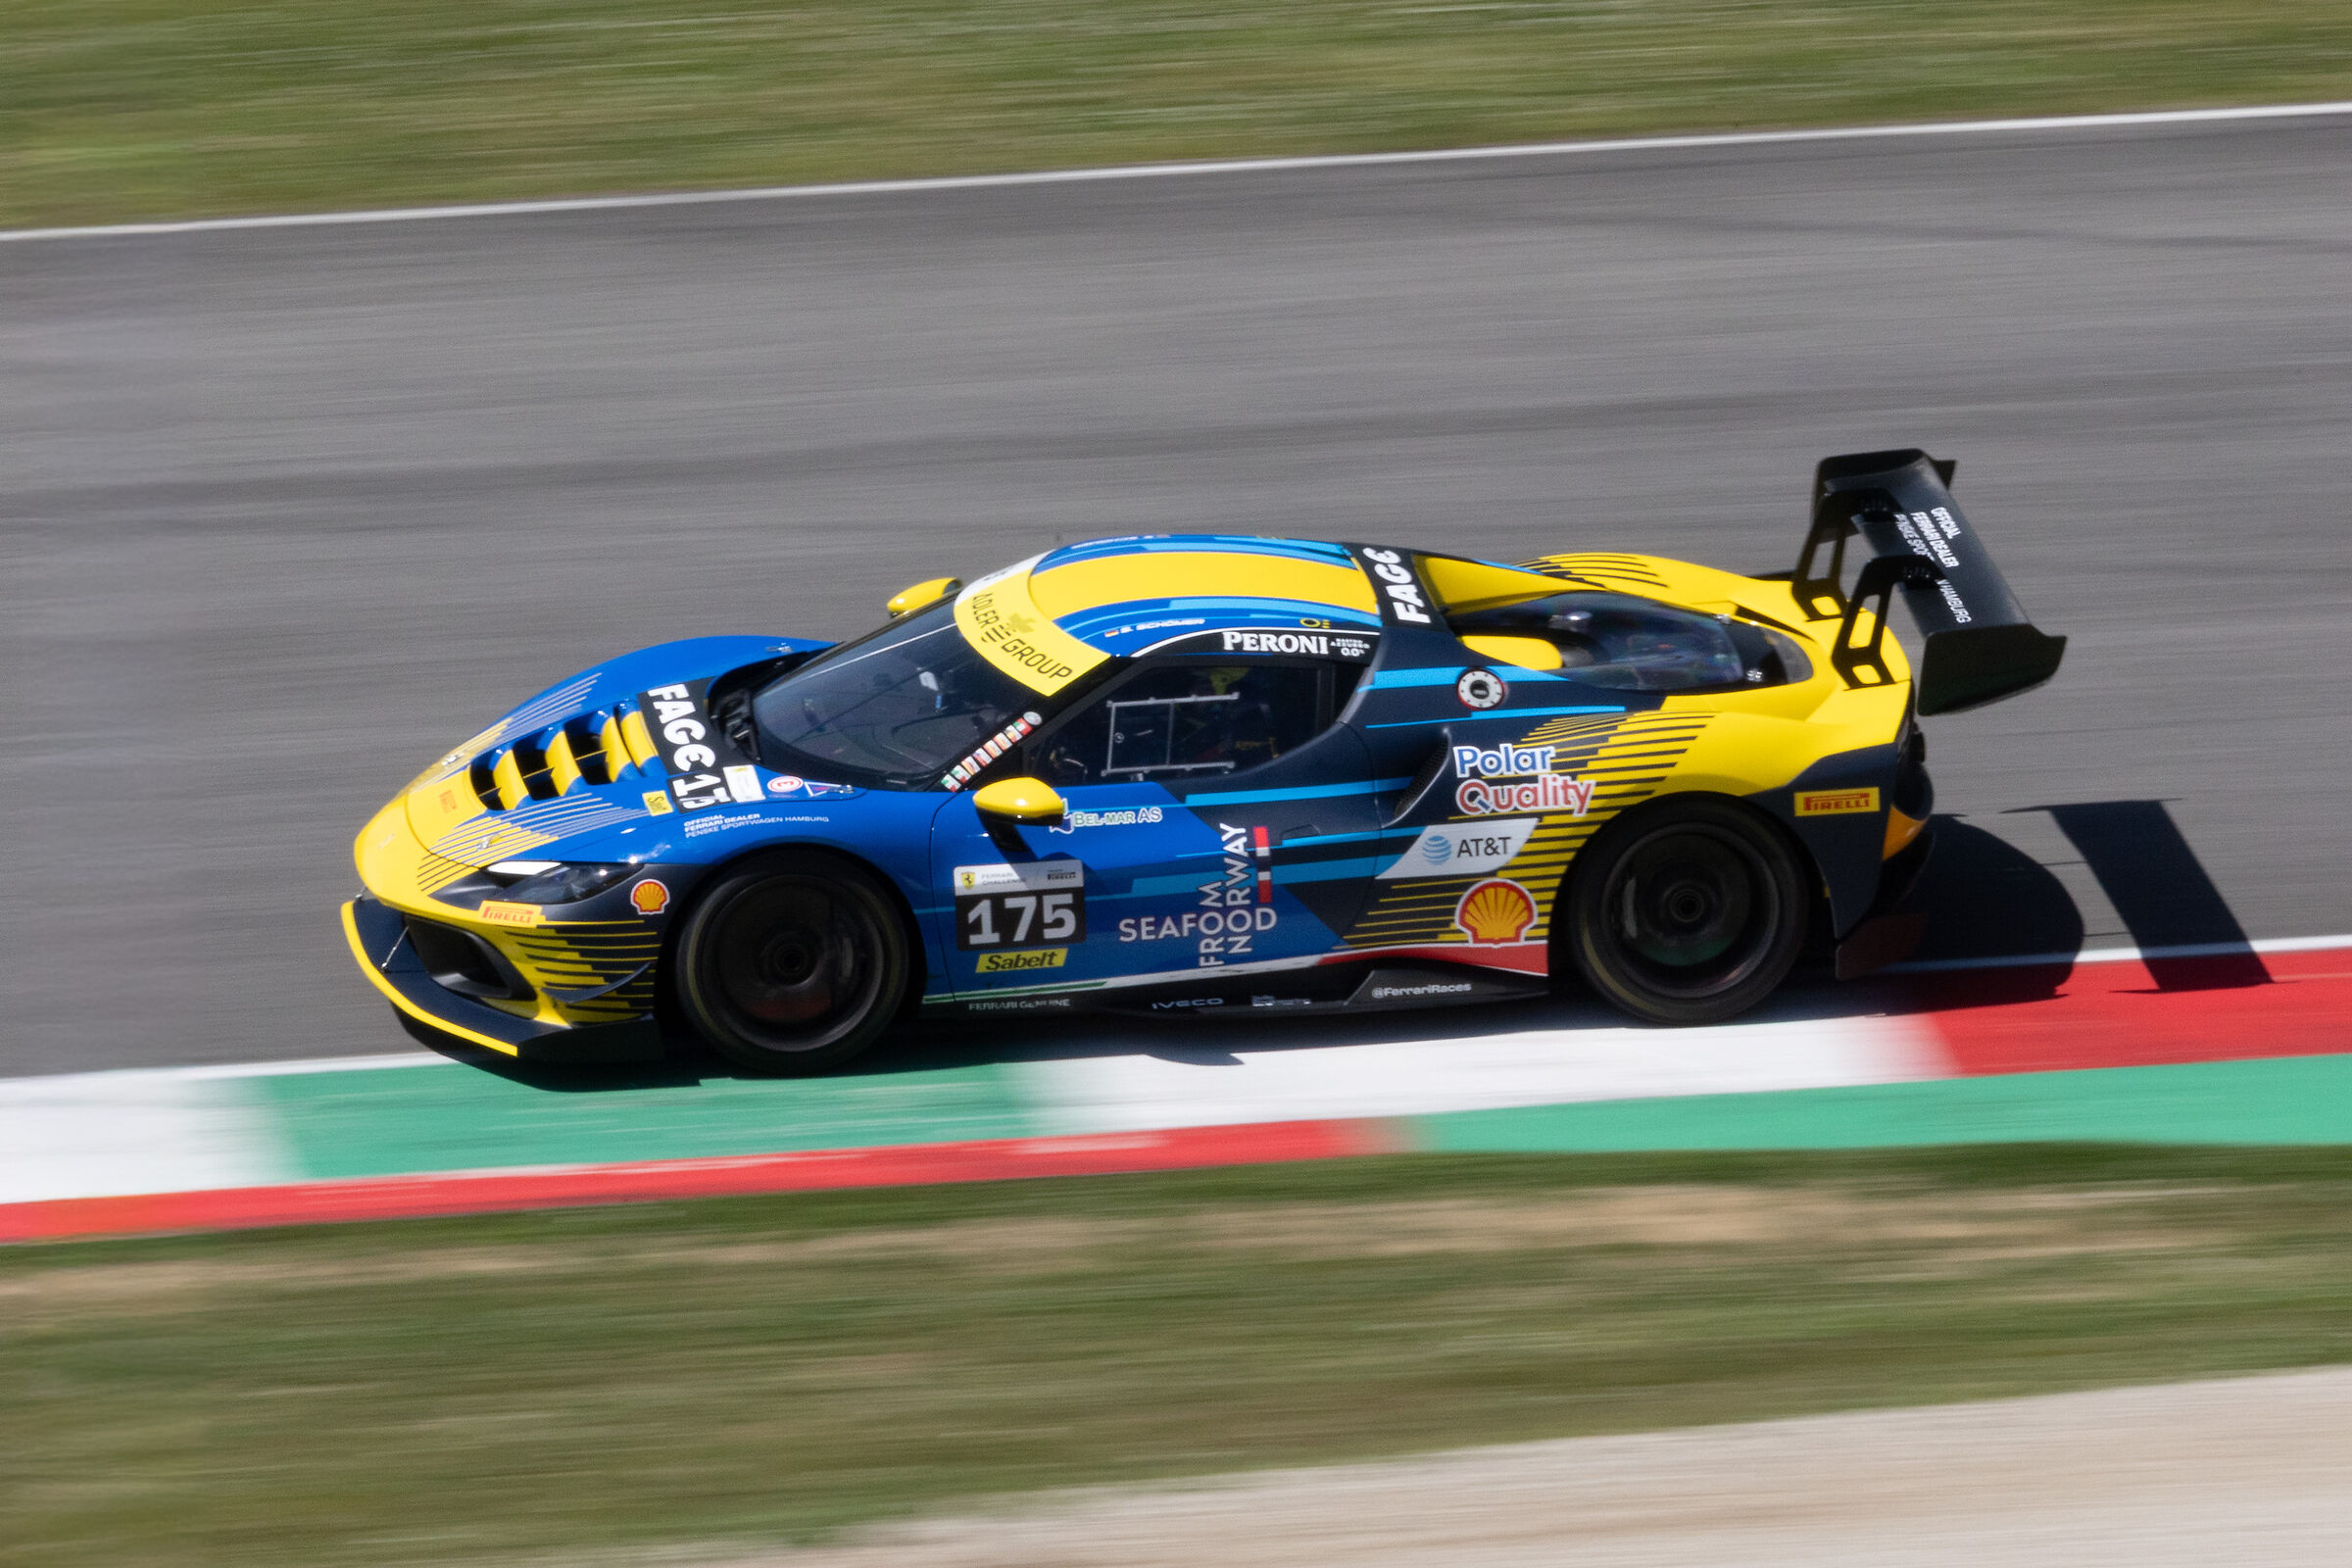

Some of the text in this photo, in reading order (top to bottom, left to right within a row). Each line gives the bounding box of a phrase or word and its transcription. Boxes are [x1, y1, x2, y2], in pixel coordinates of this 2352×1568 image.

[1931, 507, 1961, 540] OFFICIAL
[1362, 547, 1431, 624] FAGE
[972, 592, 1073, 679] ADLER GROUP
[1222, 630, 1329, 656] PERONI
[1454, 745, 1554, 777] Polar
[1457, 775, 1593, 815] Quality
[1803, 792, 1870, 811] PIRELLI
[683, 813, 725, 827] OFFICIAL
[684, 812, 760, 833] FERRARI DEALER
[685, 826, 720, 839] PENSKE
[720, 815, 783, 831] SPORTWAGEN
[1138, 807, 1163, 823] AS
[1456, 836, 1512, 858] AT&T
[1219, 822, 1252, 955] NORWAY
[482, 906, 534, 923] PIRELLI
[967, 893, 1076, 945] 175
[1118, 907, 1277, 943] SEAFOOD
[1198, 880, 1225, 967] FROM
[985, 951, 1057, 971] Sabelt
[1372, 983, 1472, 999] @FerrariRaces
[968, 1001, 1017, 1011] FERRARI
[1152, 997, 1224, 1010] IVECO
